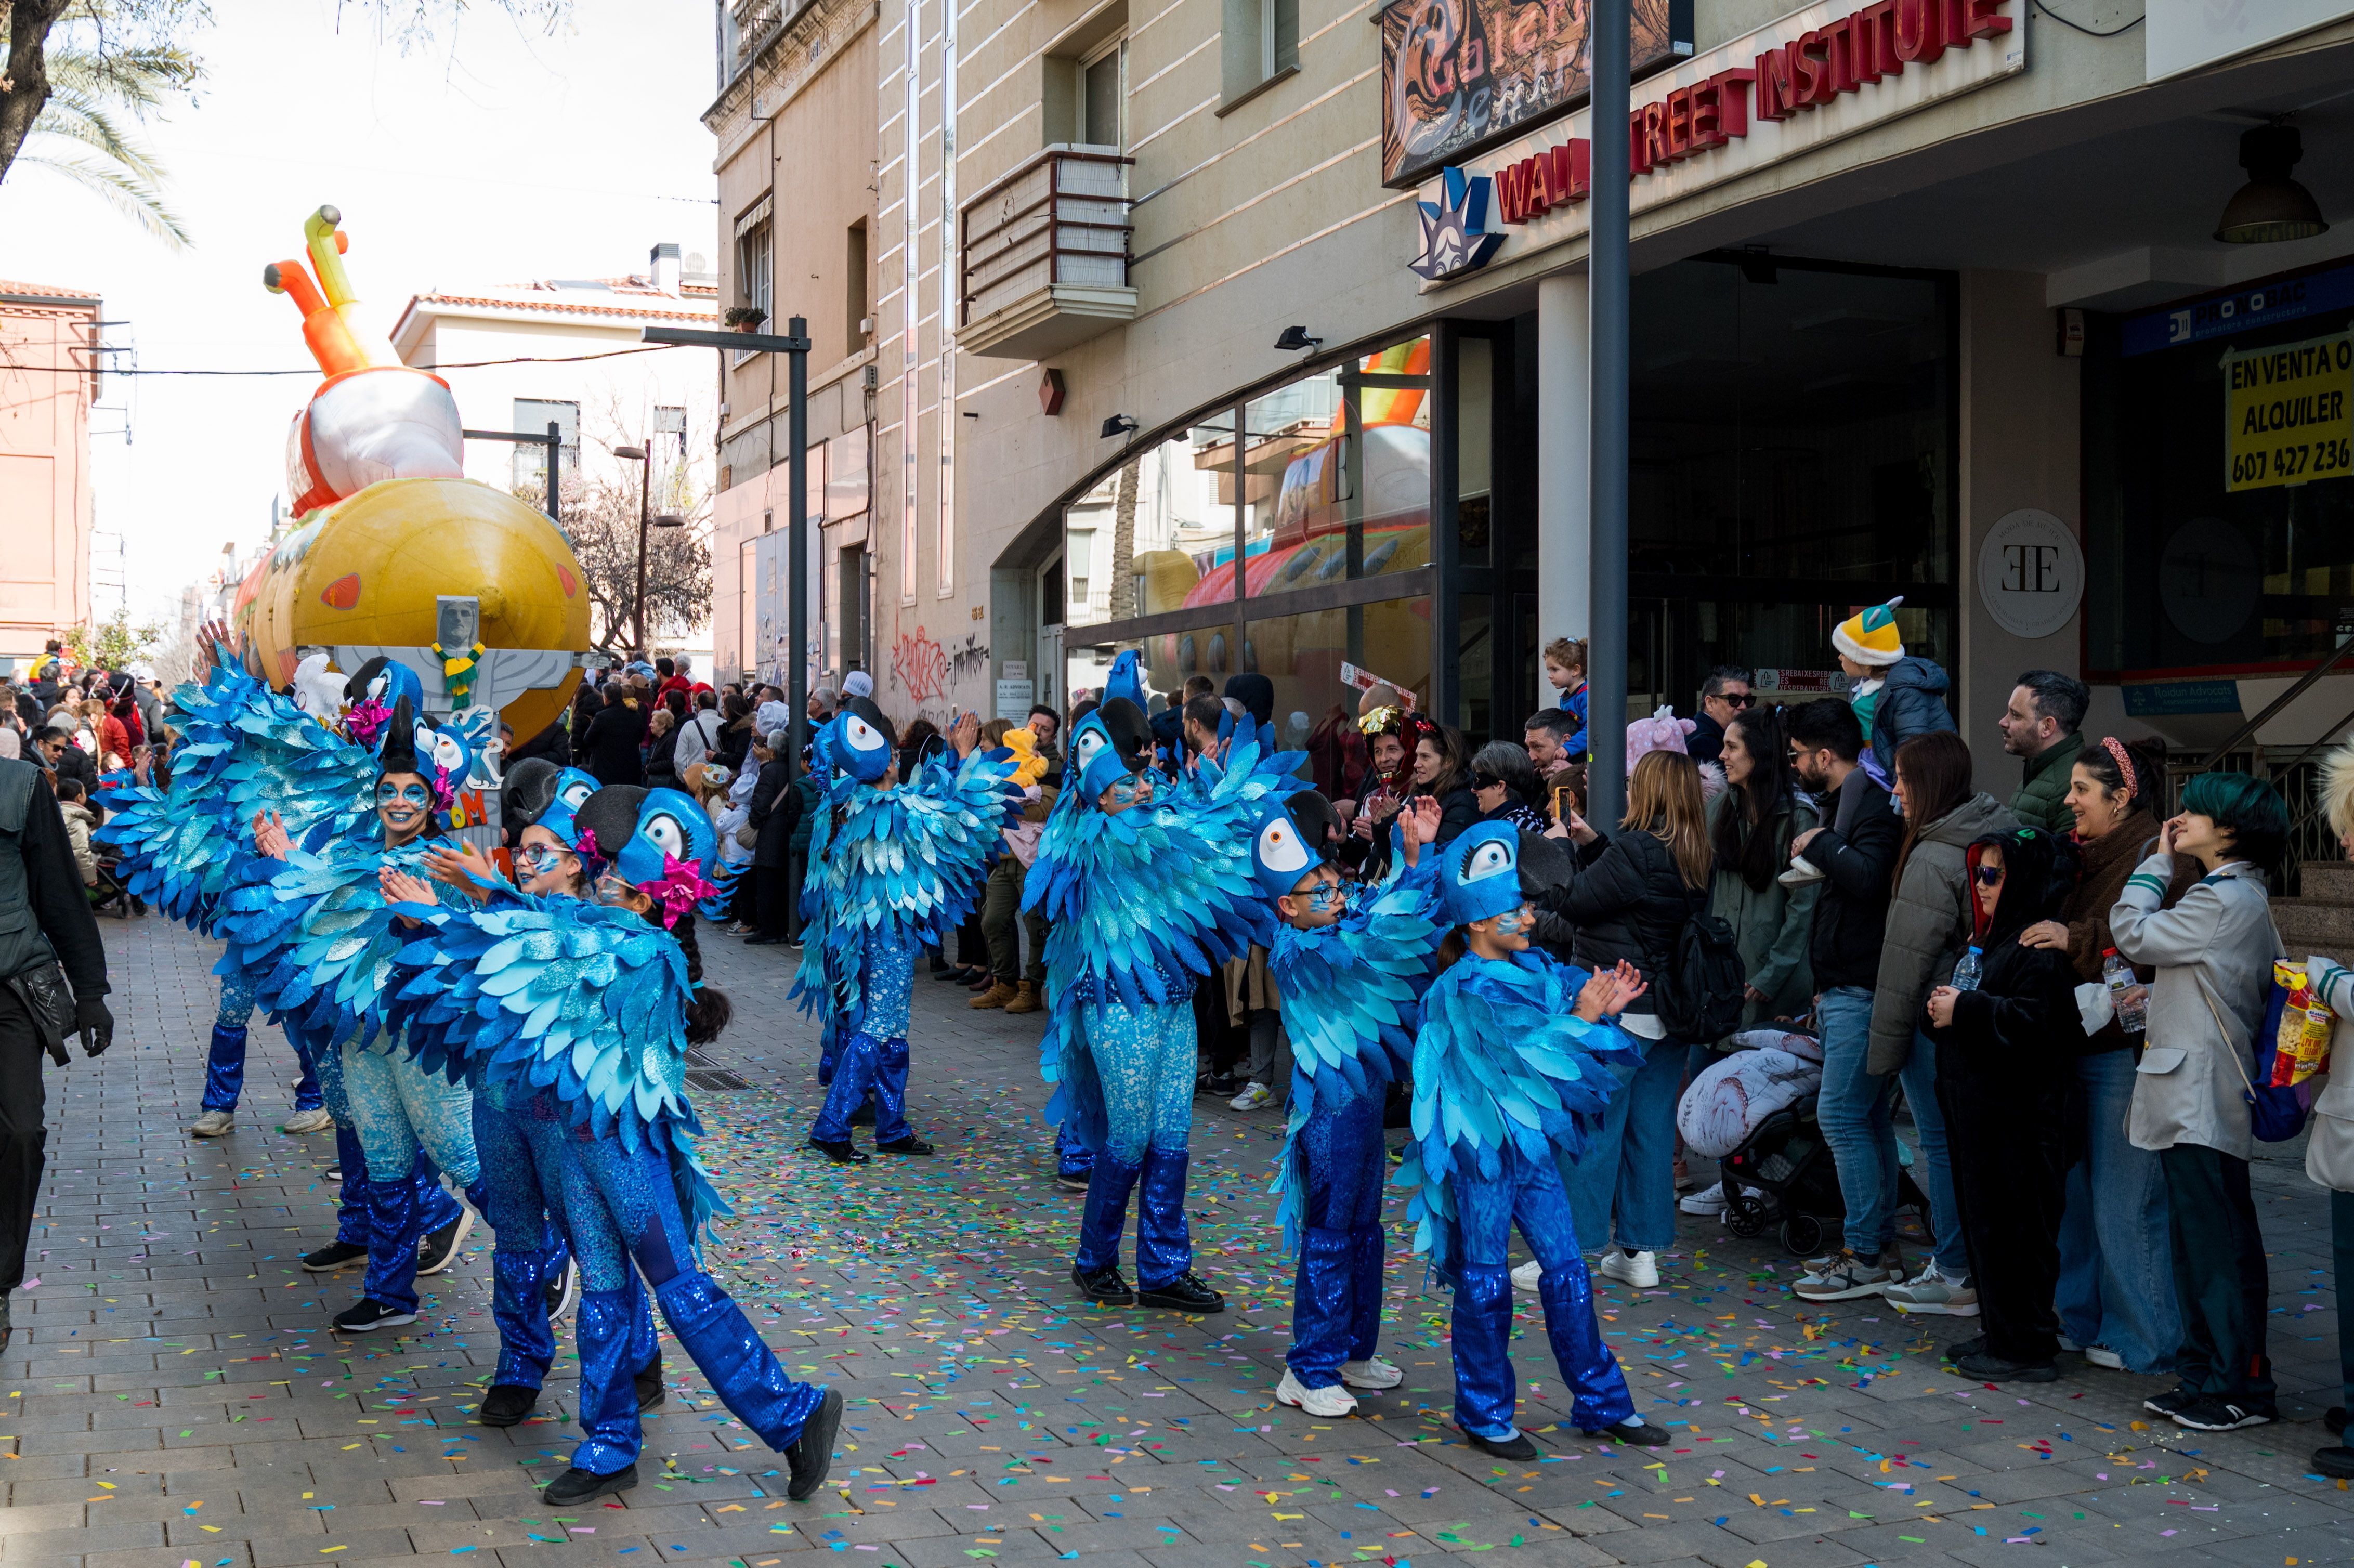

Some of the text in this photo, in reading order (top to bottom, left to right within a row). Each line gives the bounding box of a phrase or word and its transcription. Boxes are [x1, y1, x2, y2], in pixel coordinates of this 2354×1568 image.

[1495, 137, 1590, 225] WALL
[1630, 68, 1755, 181] TREET
[2196, 282, 2305, 325] PRONOBAC
[2196, 306, 2307, 337] promotora constructora
[2232, 340, 2351, 390] EN VENTA O
[2242, 390, 2343, 435] ALQUILER
[2232, 438, 2350, 483] 607 427 236
[1998, 522, 2020, 539] MODA
[2036, 522, 2061, 541] MUJER
[2154, 685, 2232, 699] Raidun Advocats
